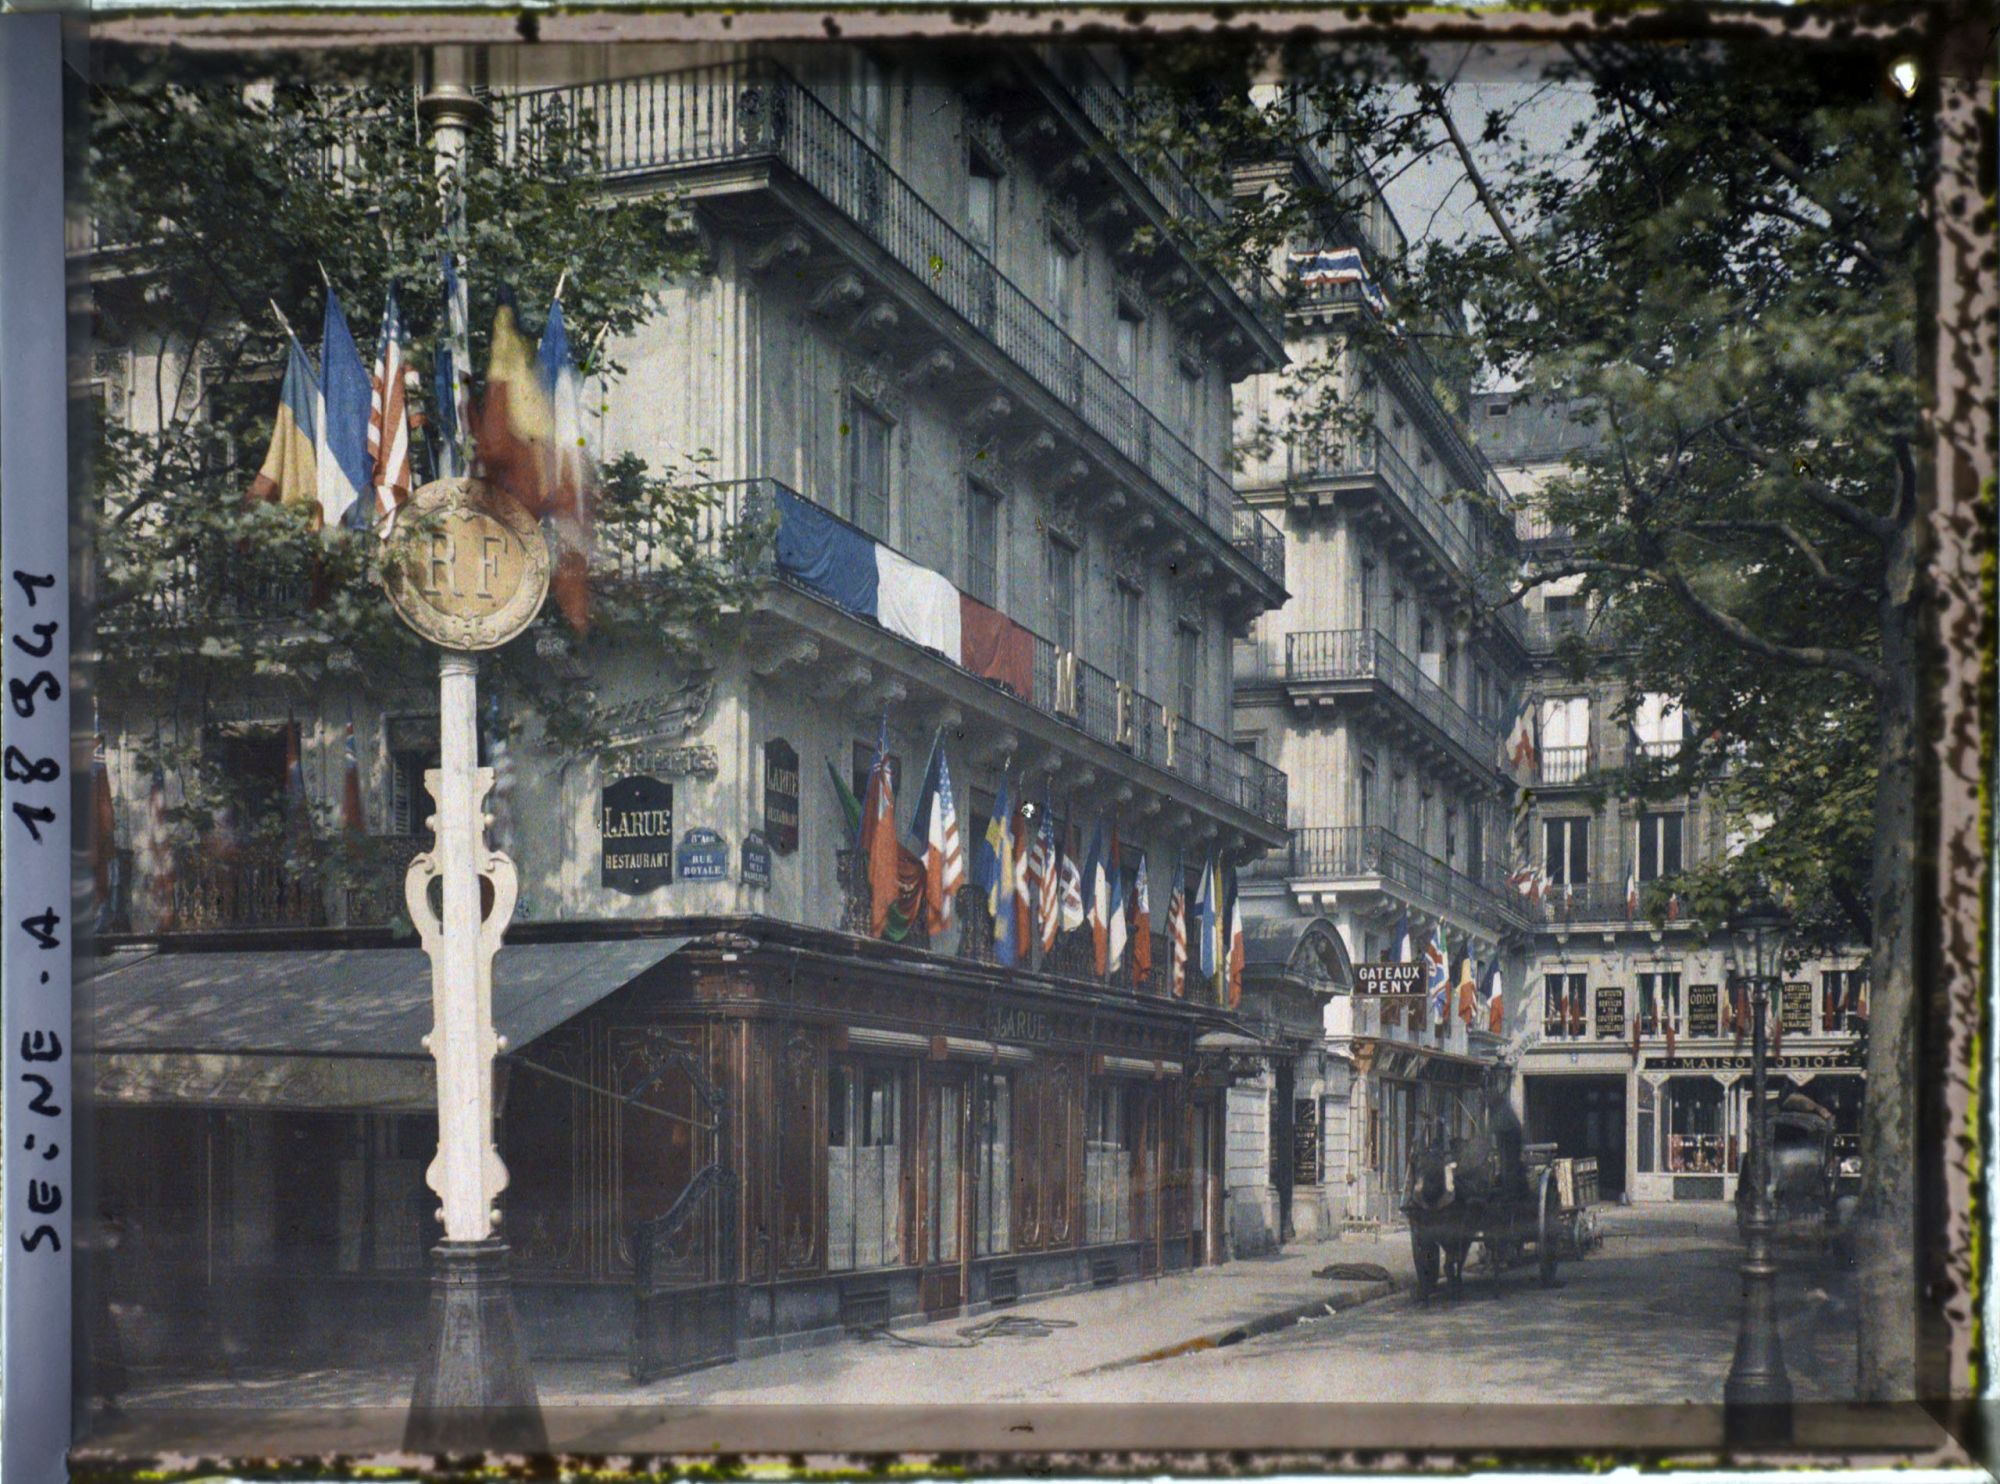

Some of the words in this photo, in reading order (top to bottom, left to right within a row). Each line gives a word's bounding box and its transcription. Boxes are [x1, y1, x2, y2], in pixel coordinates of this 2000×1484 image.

[603, 806, 671, 839] LARUE
[605, 852, 670, 870] RESTAURANT
[692, 855, 713, 865] RUE
[683, 865, 722, 877] ROYALE
[1359, 967, 1420, 980] GATEAUX
[1367, 981, 1413, 994] PENY
[1690, 994, 1717, 1005] ODIOT
[991, 1009, 1047, 1041] LARUE
[1776, 1057, 1838, 1068] ODIOT
